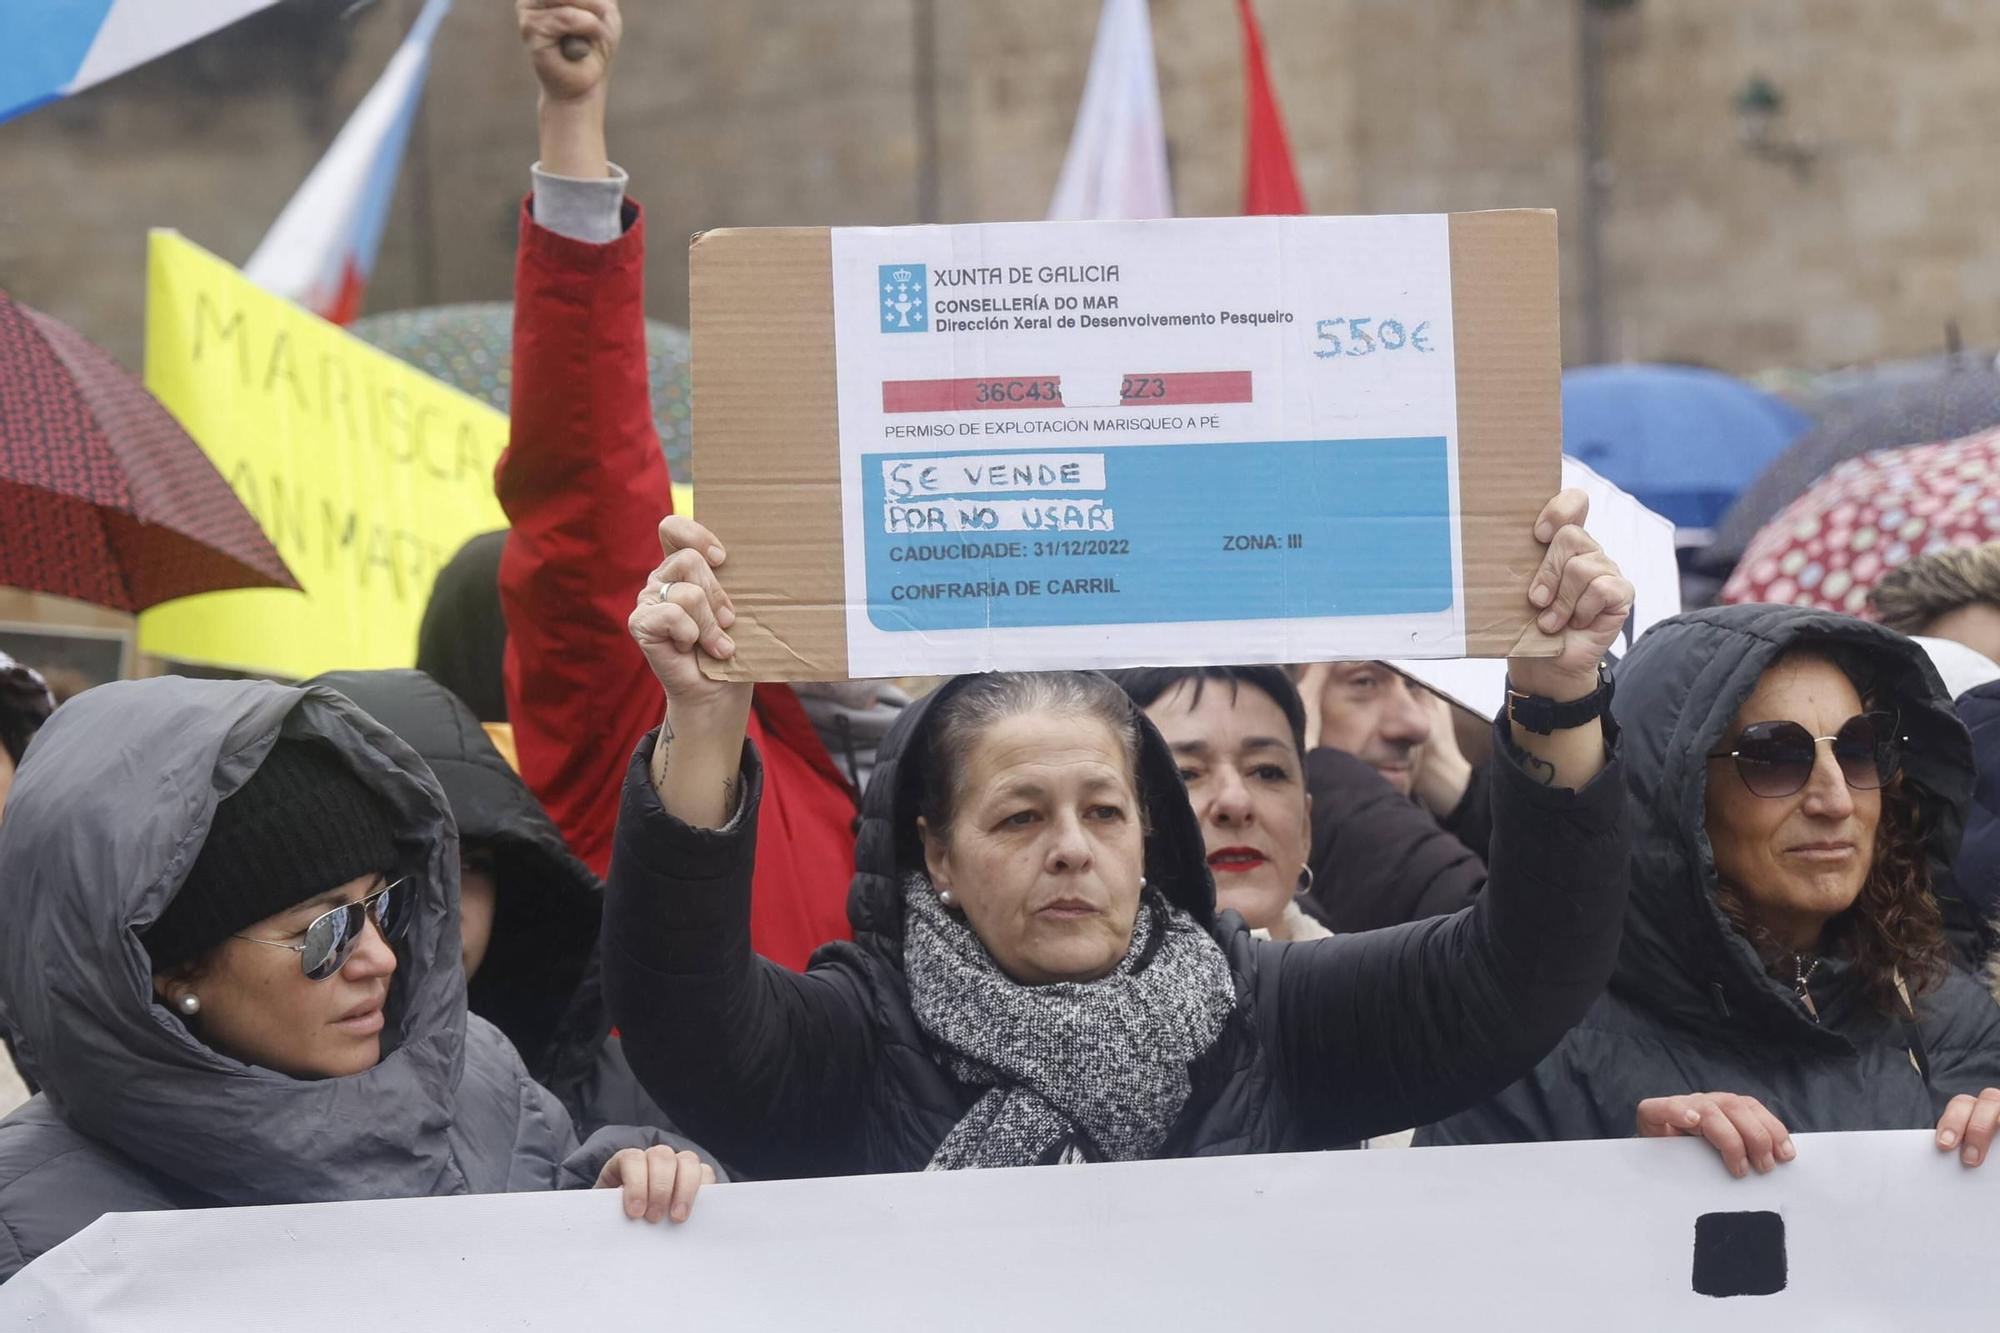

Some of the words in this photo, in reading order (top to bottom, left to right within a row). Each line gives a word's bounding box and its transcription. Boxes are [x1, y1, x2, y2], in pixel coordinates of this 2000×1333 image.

[934, 268, 1002, 287] XUNTA
[1009, 267, 1033, 283] DE
[1038, 265, 1120, 283] GALICIA
[935, 293, 1050, 314] CONSELLERÍA
[1055, 297, 1078, 311] DO
[1083, 296, 1119, 310] MAR
[936, 316, 1009, 333] Dirección
[1014, 314, 1052, 330] Xeral
[1057, 314, 1076, 328] de
[1081, 312, 1216, 328] Desenvolvemento
[1220, 309, 1294, 329] Pesqueiro
[1314, 316, 1435, 360] 550€
[885, 422, 955, 438] PERMISO
[959, 421, 980, 434] DE
[985, 415, 1089, 434] EXPLOTACIÓN
[1093, 417, 1183, 432] MARISQUEO
[1186, 417, 1197, 429] A
[1200, 414, 1221, 428] PÉ
[888, 463, 939, 498] SE
[963, 462, 1081, 488] VENDE
[890, 505, 948, 532] POR
[960, 505, 999, 530] NO
[1022, 504, 1110, 530] USAR
[889, 542, 1029, 563] CADUCIDADE:
[1033, 538, 1131, 557] 31/12/2022
[1223, 534, 1283, 551] ZONA:
[1287, 533, 1303, 549] III
[891, 578, 1010, 601] CONFRARÍA
[1015, 580, 1041, 596] DE
[1046, 577, 1121, 595] CARRIL
